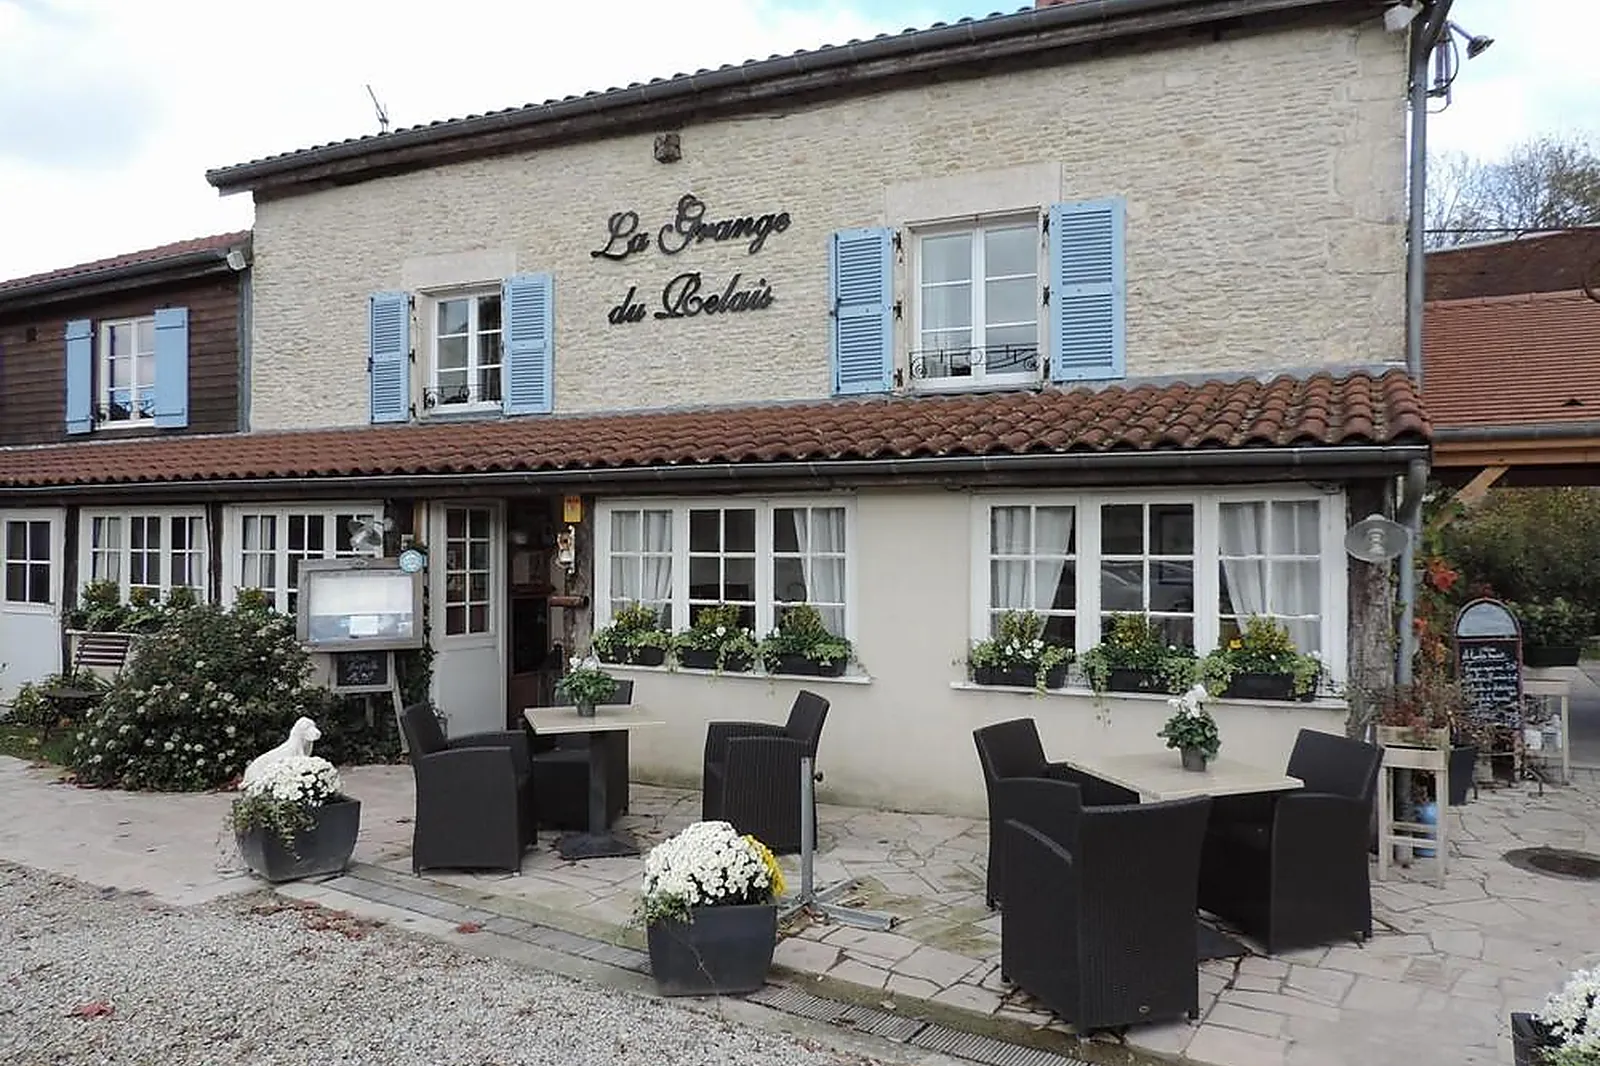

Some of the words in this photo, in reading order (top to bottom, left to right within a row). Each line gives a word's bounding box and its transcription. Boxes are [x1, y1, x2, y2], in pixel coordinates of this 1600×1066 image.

[591, 211, 650, 260] La
[658, 193, 791, 255] Grange
[608, 286, 646, 325] du
[653, 271, 775, 319] Relais
